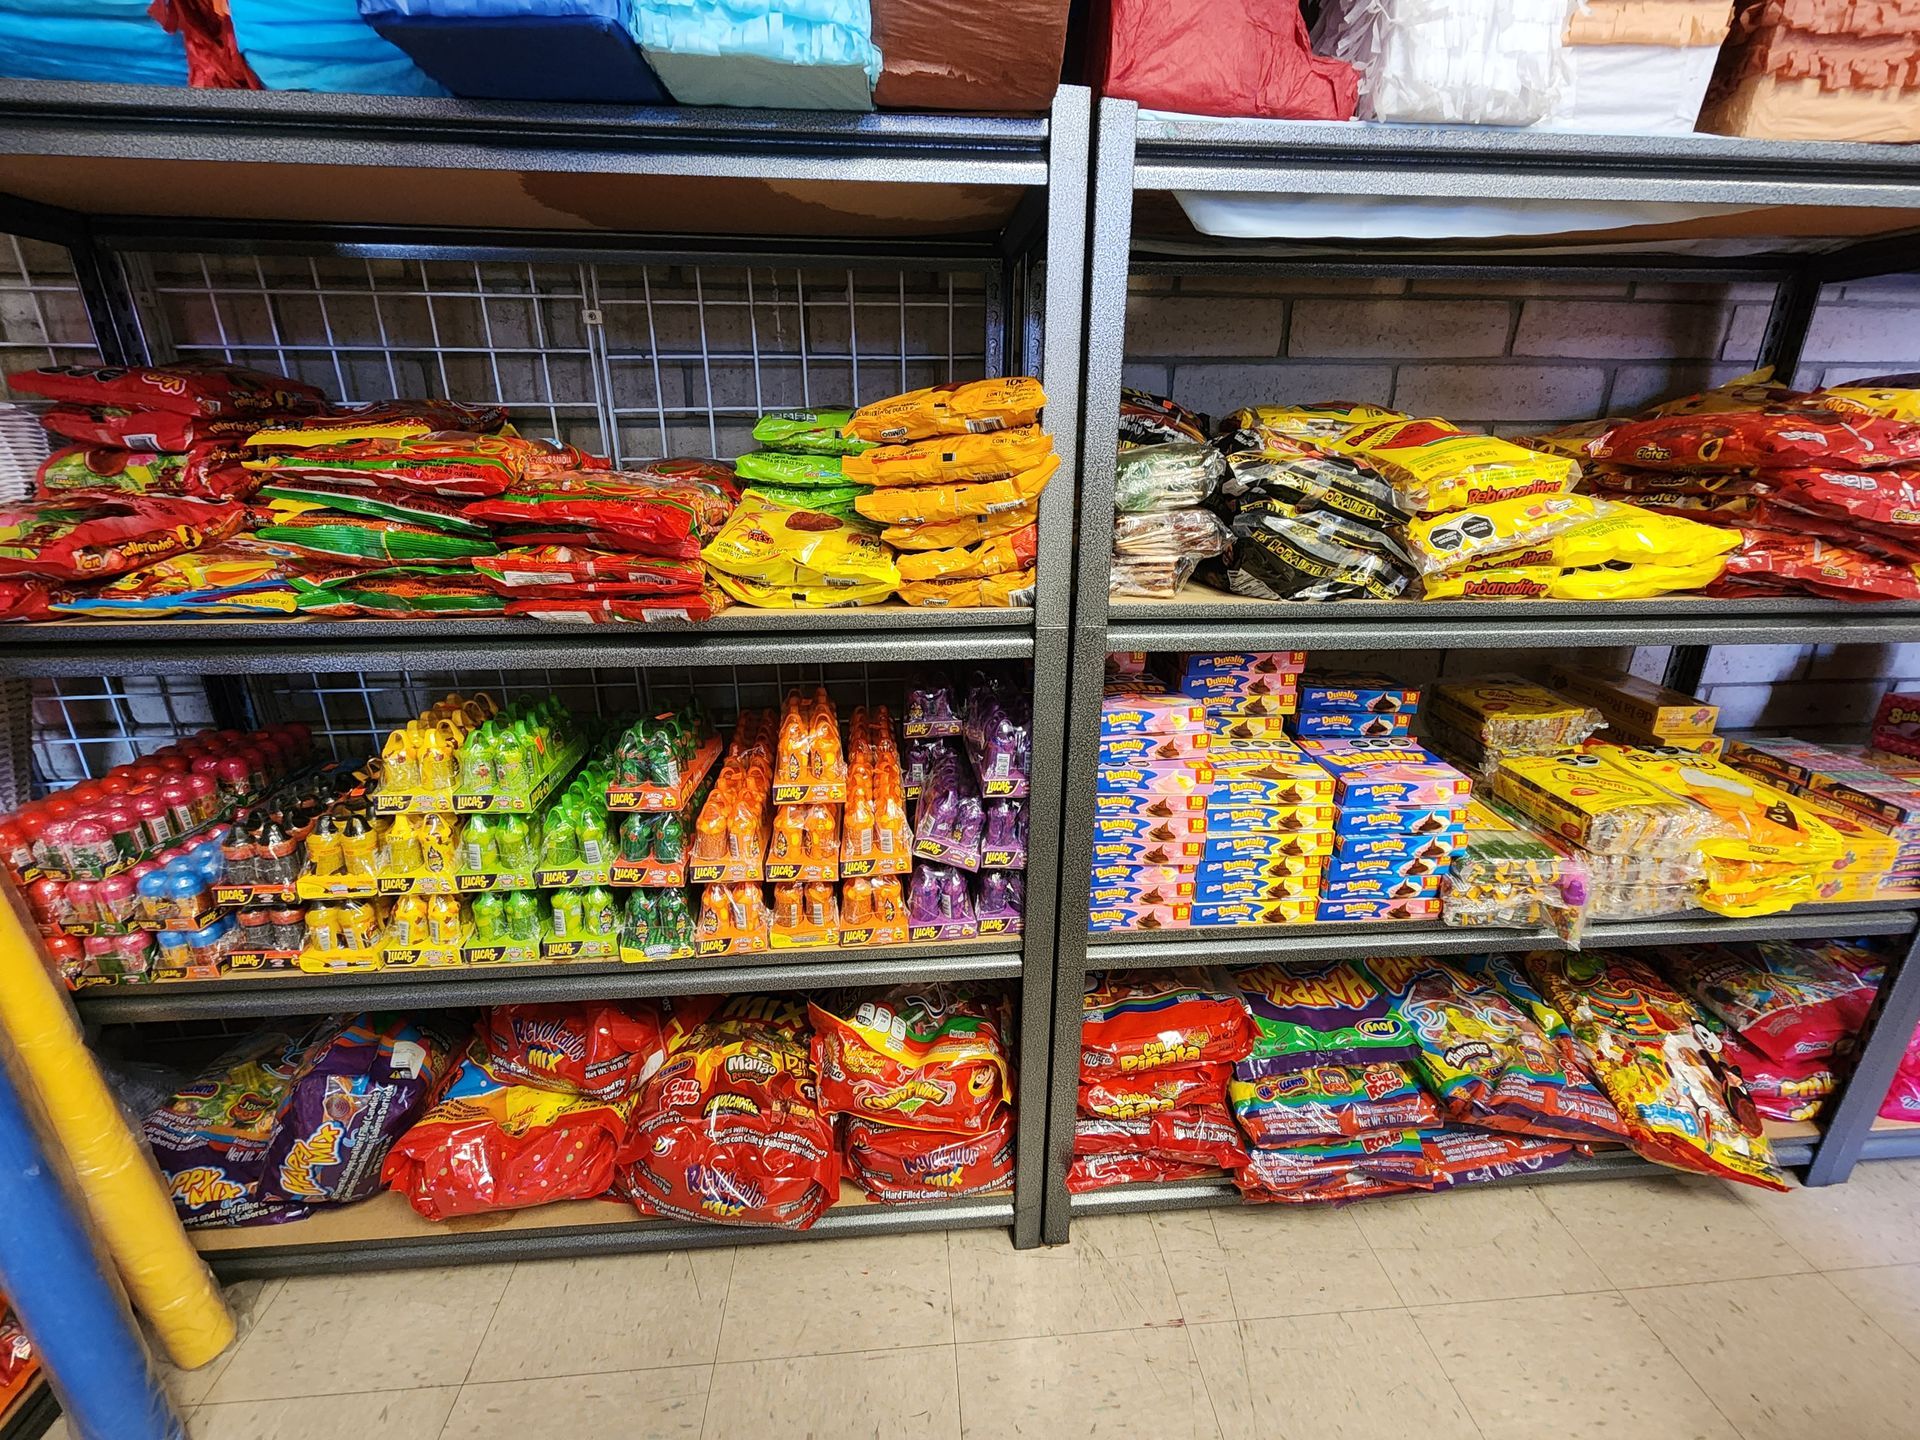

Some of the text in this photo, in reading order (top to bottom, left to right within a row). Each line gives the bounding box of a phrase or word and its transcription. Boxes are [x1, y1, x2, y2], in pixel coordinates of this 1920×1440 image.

[1637, 448, 1671, 461] Elotes
[1468, 479, 1562, 505] Rebanaditas
[748, 532, 774, 545] FRESA
[906, 724, 930, 736] LUCAS
[776, 786, 804, 800] LUCAS
[986, 780, 1013, 794] LUCAS
[377, 796, 406, 809] LUCAS
[457, 796, 486, 809] LUCAS
[610, 792, 637, 806] LUCAS
[917, 841, 943, 855] LUCAS
[984, 852, 1010, 866] LUCAS
[614, 868, 641, 882] LUCAS
[693, 866, 724, 880] LUCAS
[769, 866, 800, 880] LUCAS
[844, 860, 871, 876] LUCAS
[460, 875, 490, 889] LUCAS
[542, 871, 571, 886] LUCAS
[380, 879, 410, 893] LUCAS
[217, 889, 248, 903] LUCAS
[912, 926, 938, 940] LUCAS
[980, 919, 1007, 934] LUCAS
[843, 929, 870, 944] LUCAS
[547, 941, 576, 956] LUCAS
[699, 938, 731, 952] LUCAS
[231, 953, 260, 968] LUCAS
[387, 950, 416, 964] LUCAS
[470, 947, 500, 961] LUCAS
[1271, 965, 1378, 1009] HAPPY
[527, 1047, 565, 1074] MIX
[727, 1054, 777, 1076] Mango
[168, 1167, 222, 1197] PPY
[923, 1167, 964, 1188] MIX
[188, 1182, 243, 1206] MIX
